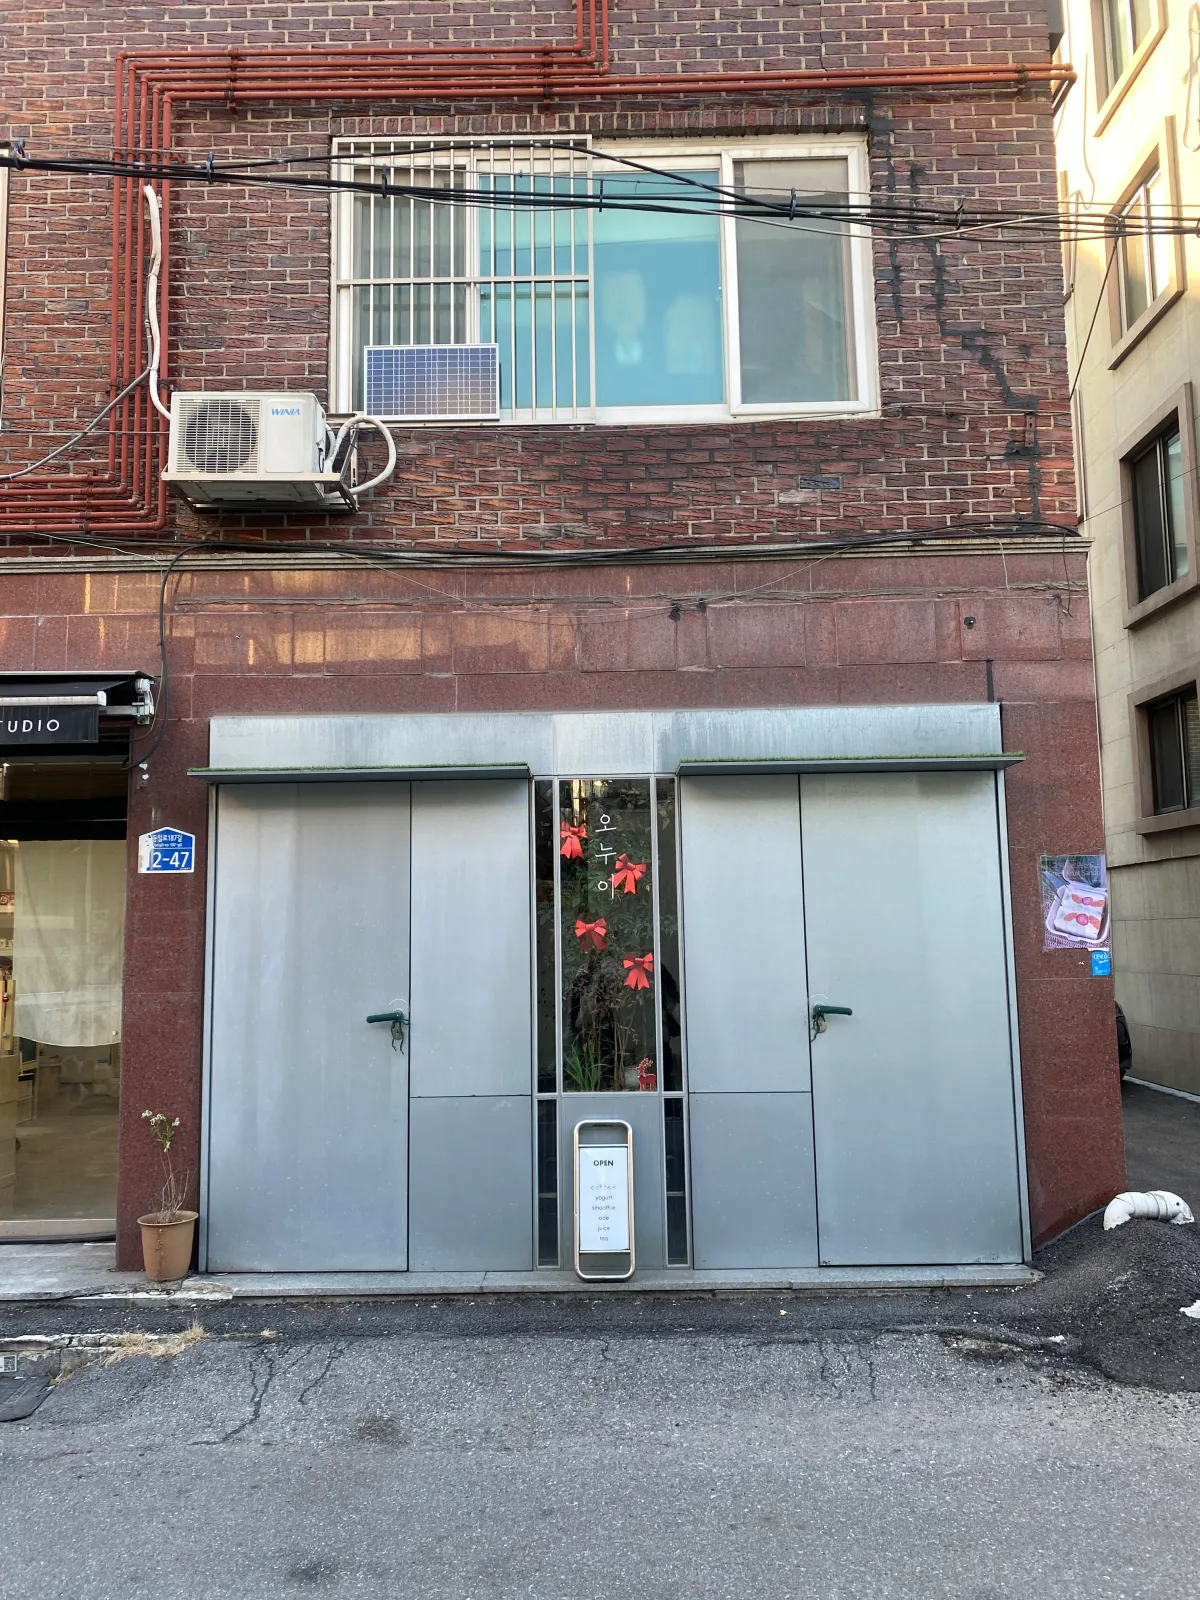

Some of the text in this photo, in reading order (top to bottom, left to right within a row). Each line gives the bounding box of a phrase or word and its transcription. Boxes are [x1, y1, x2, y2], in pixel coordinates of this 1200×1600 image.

[271, 408, 300, 416] WINIA
[0, 719, 60, 733] UDIO
[595, 813, 617, 899] 오누이
